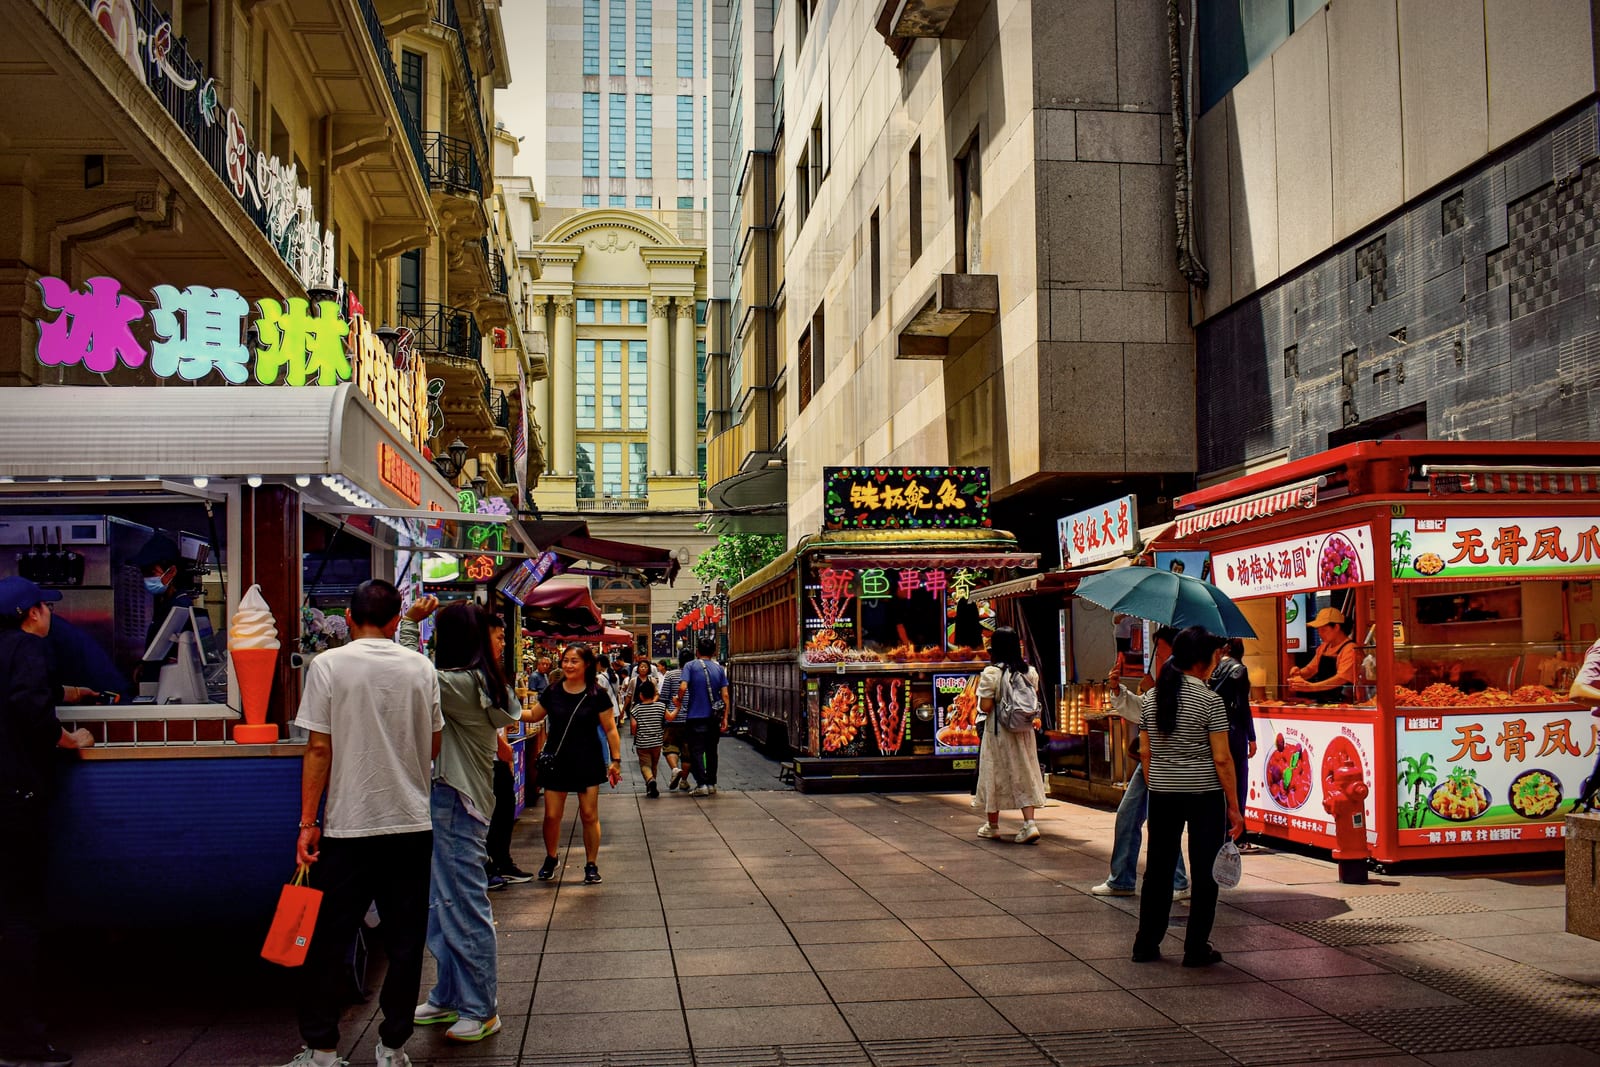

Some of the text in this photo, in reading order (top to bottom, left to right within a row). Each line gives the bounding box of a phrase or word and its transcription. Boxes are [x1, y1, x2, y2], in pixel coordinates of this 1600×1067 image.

[36, 276, 352, 386] 冰淇淋
[850, 478, 966, 515] 铁板鱿鱼
[1392, 505, 1404, 515] 01
[1072, 501, 1130, 554] 超级大串
[1448, 525, 1600, 565] 无骨凤爪
[819, 568, 976, 600] 鱿鱼串串香
[1236, 546, 1307, 586] 杨梅冰汤圆
[1446, 718, 1598, 763] 无骨凤
